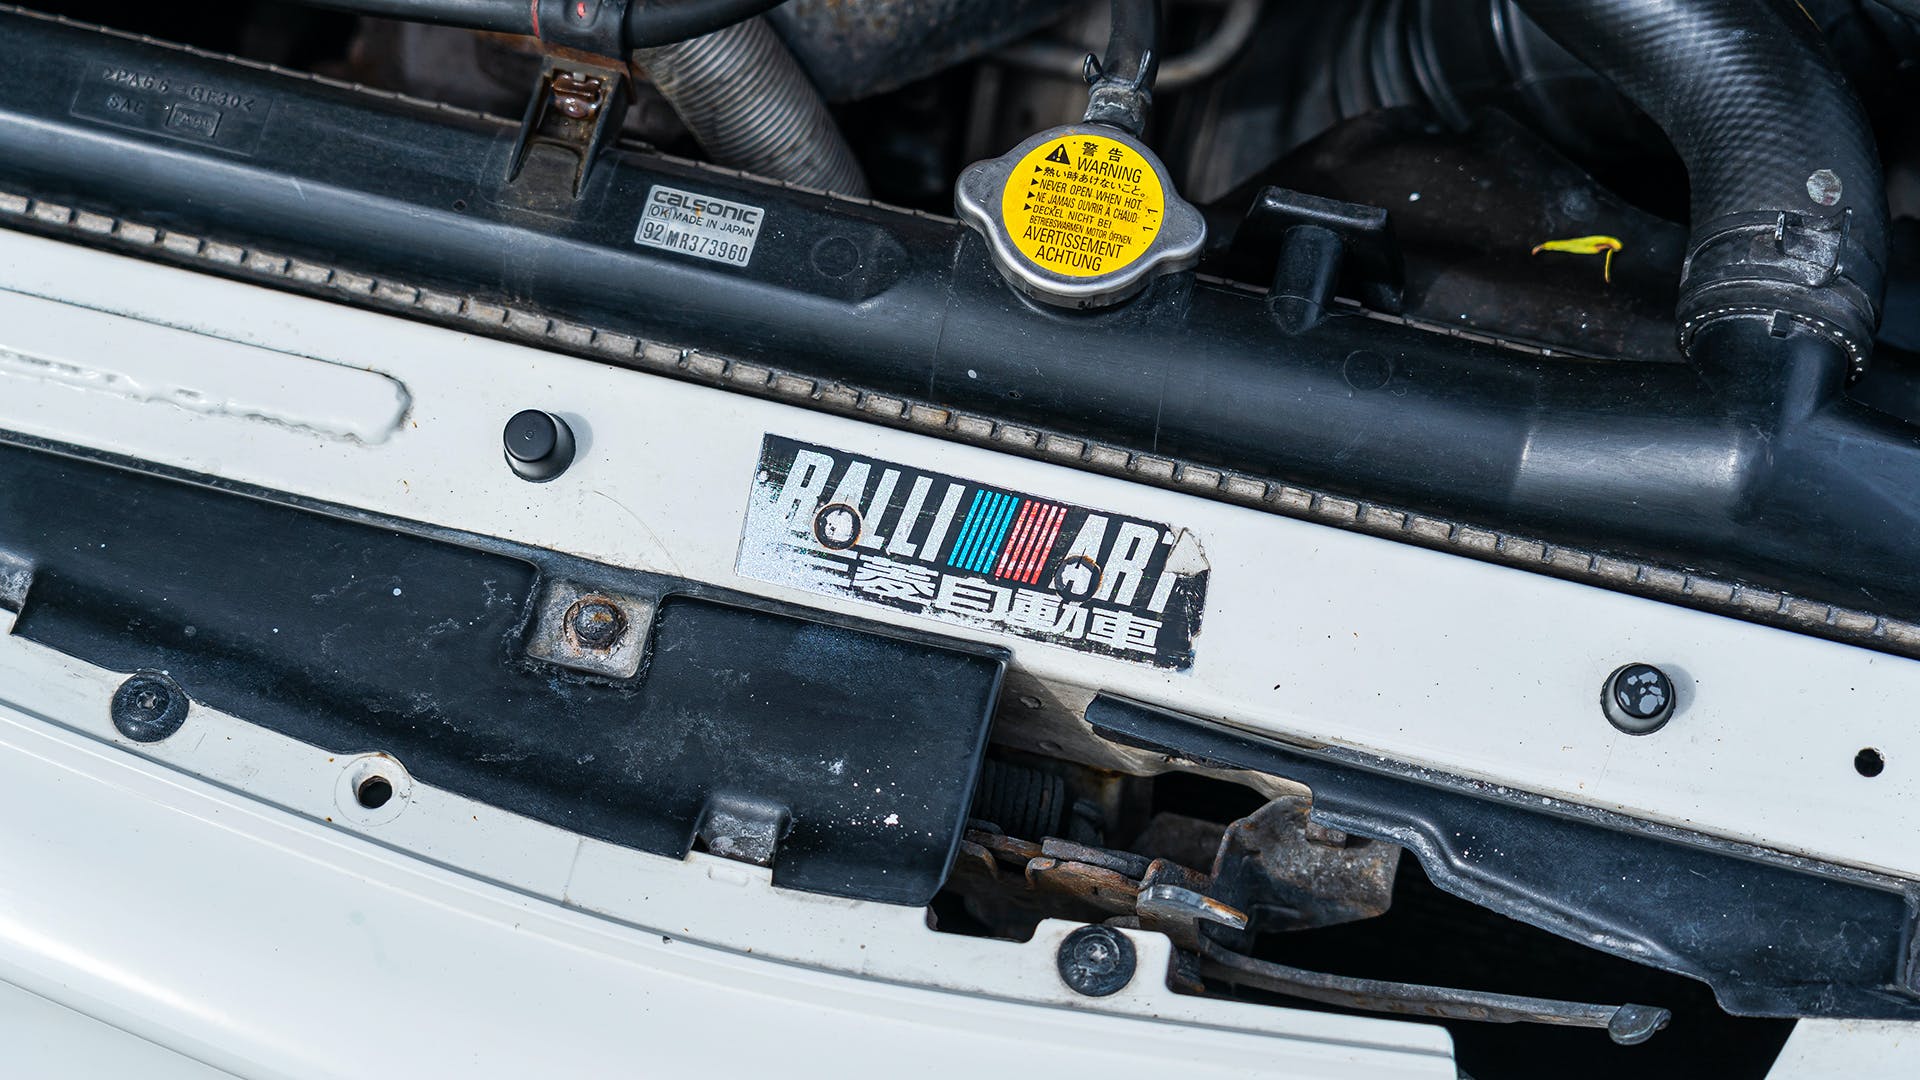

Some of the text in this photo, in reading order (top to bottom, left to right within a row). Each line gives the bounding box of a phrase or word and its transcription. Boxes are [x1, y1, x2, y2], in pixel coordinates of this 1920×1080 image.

[1077, 156, 1142, 183] WARNING
[1036, 191, 1046, 203] NE
[1048, 194, 1076, 209] JAMAIS
[1078, 201, 1104, 216] OUVRIR
[1040, 179, 1143, 211] NEVER OPEN WHEN HOT.
[650, 206, 754, 238] OK MADE IN JAPAN
[1033, 205, 1112, 229] DECKEL NICHT BEI
[643, 221, 748, 262] 92 MR373960
[1023, 225, 1123, 259] AVERTISSEMENT
[1085, 227, 1108, 240] MOTOR
[1035, 245, 1102, 271] ACHTUNG
[785, 546, 1163, 655] 三菱自動車
